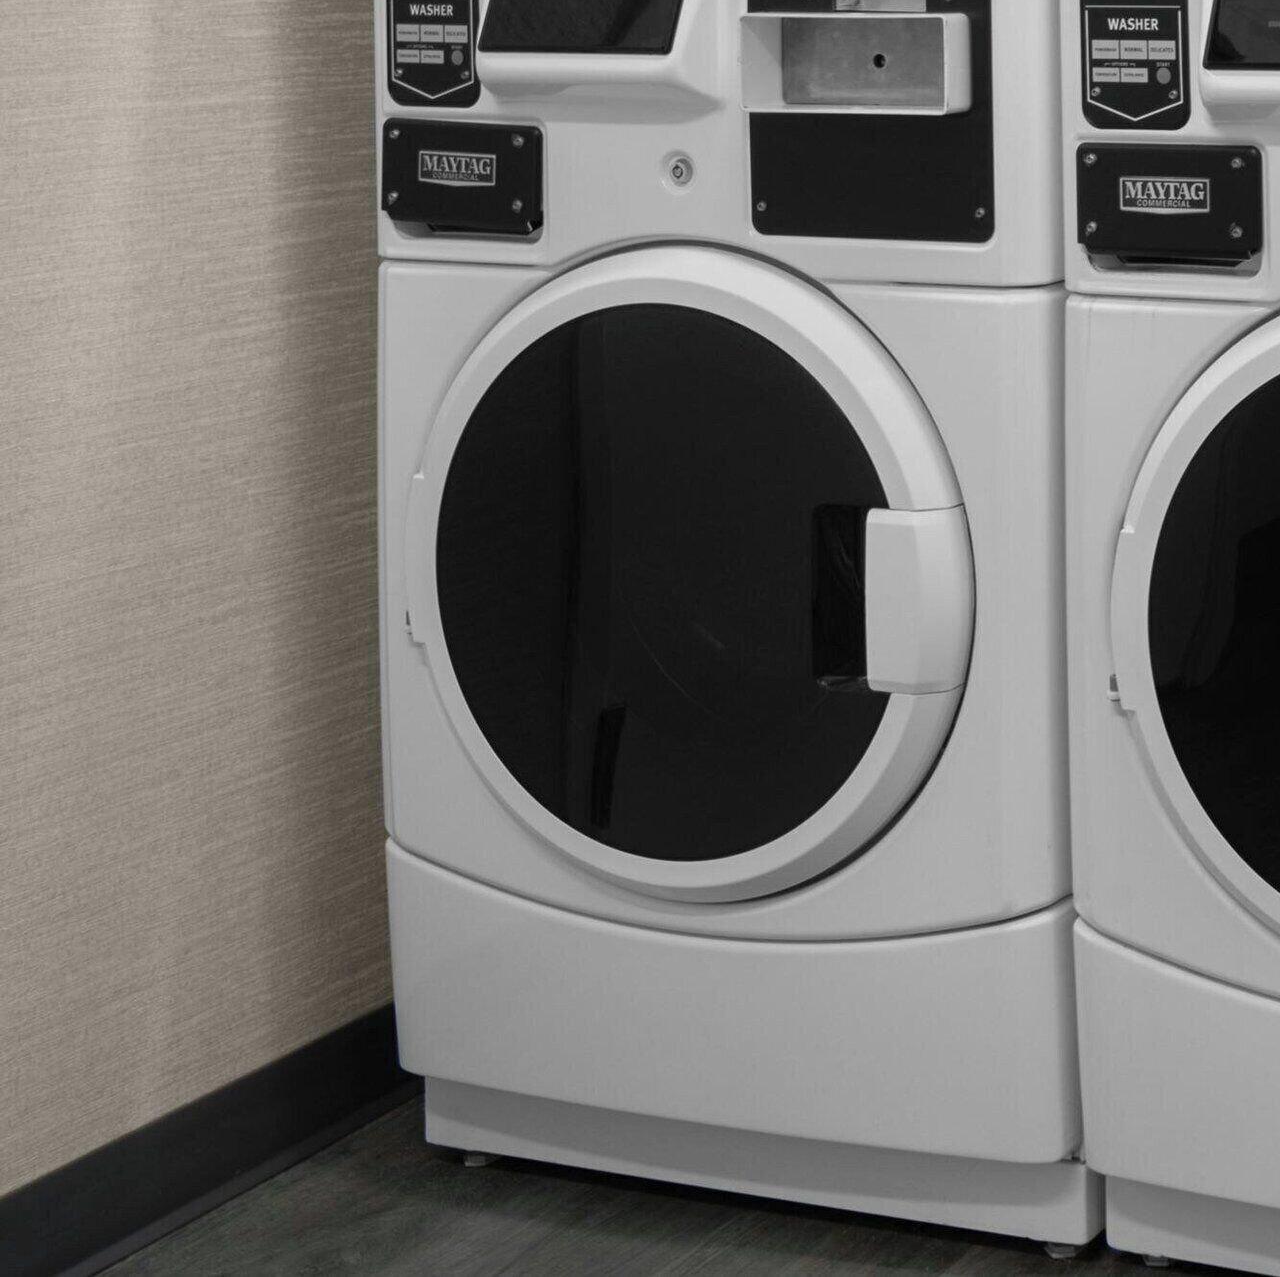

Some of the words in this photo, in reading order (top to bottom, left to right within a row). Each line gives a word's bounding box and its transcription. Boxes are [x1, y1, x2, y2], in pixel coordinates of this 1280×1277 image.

[410, 4, 454, 16] WASHER
[1107, 18, 1159, 31] WASHER
[422, 155, 491, 175] MAYTAG
[1124, 181, 1205, 200] MAYTAG
[1136, 199, 1191, 208] COMMERCIAL
